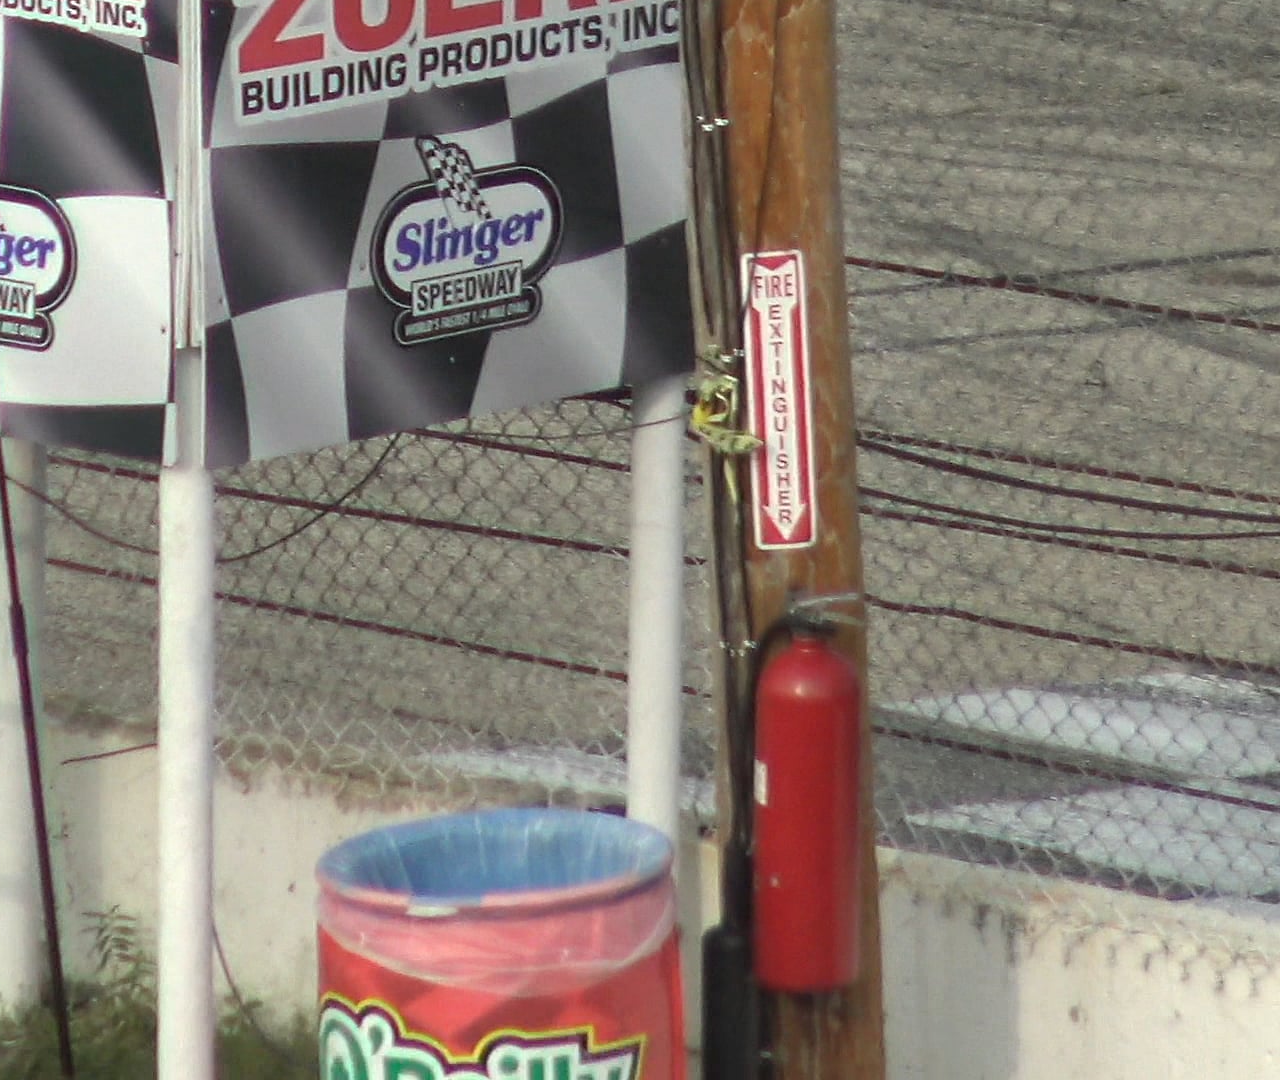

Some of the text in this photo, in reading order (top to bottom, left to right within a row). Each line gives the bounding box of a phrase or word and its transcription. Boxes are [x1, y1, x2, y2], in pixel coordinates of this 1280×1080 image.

[95, 0, 143, 30] INC.
[240, 53, 408, 117] BUILDING
[420, 14, 612, 82] PRODUCTS,
[393, 208, 545, 273] Slinger
[416, 267, 519, 312] SPEEDWAY
[754, 273, 794, 299] FIRE
[768, 303, 793, 525] EXTINGUISHER
